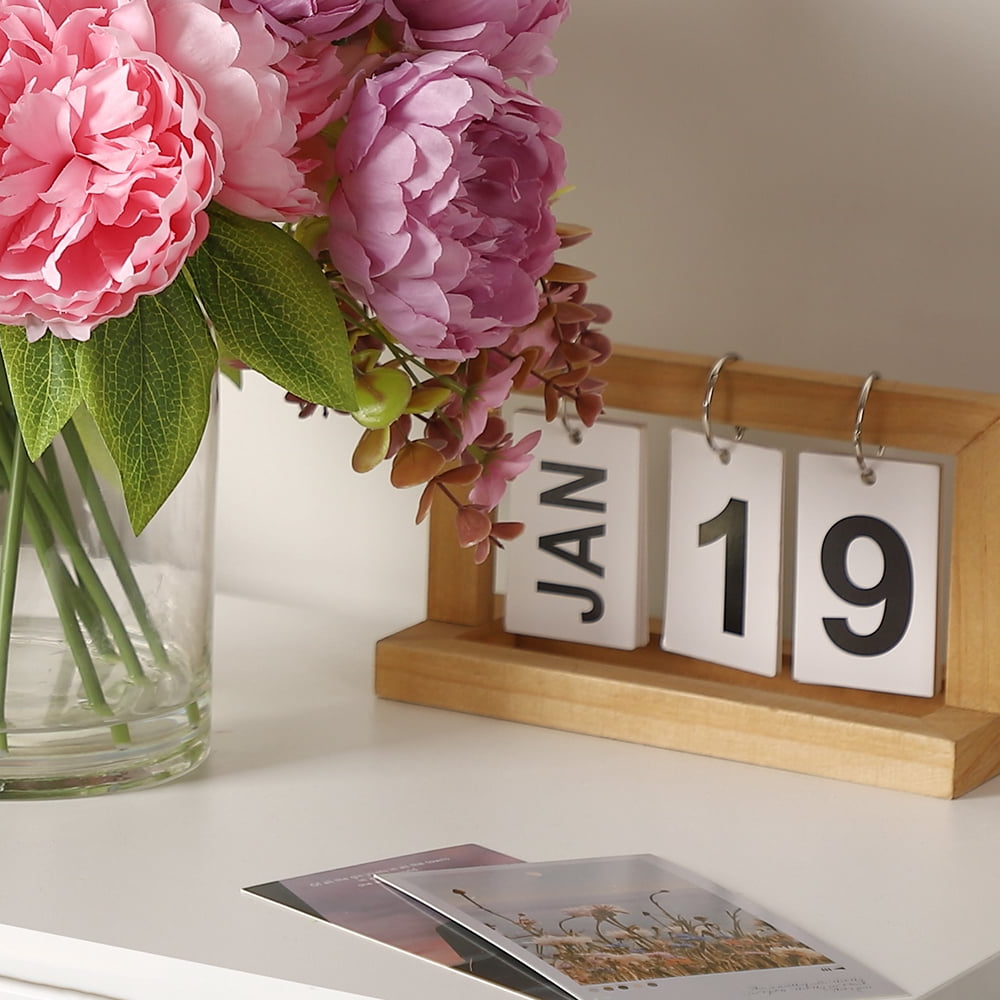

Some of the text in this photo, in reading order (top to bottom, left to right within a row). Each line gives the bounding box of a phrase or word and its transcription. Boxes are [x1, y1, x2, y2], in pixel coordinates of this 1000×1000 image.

[536, 460, 608, 624] JAN
[698, 497, 914, 657] 1 9
